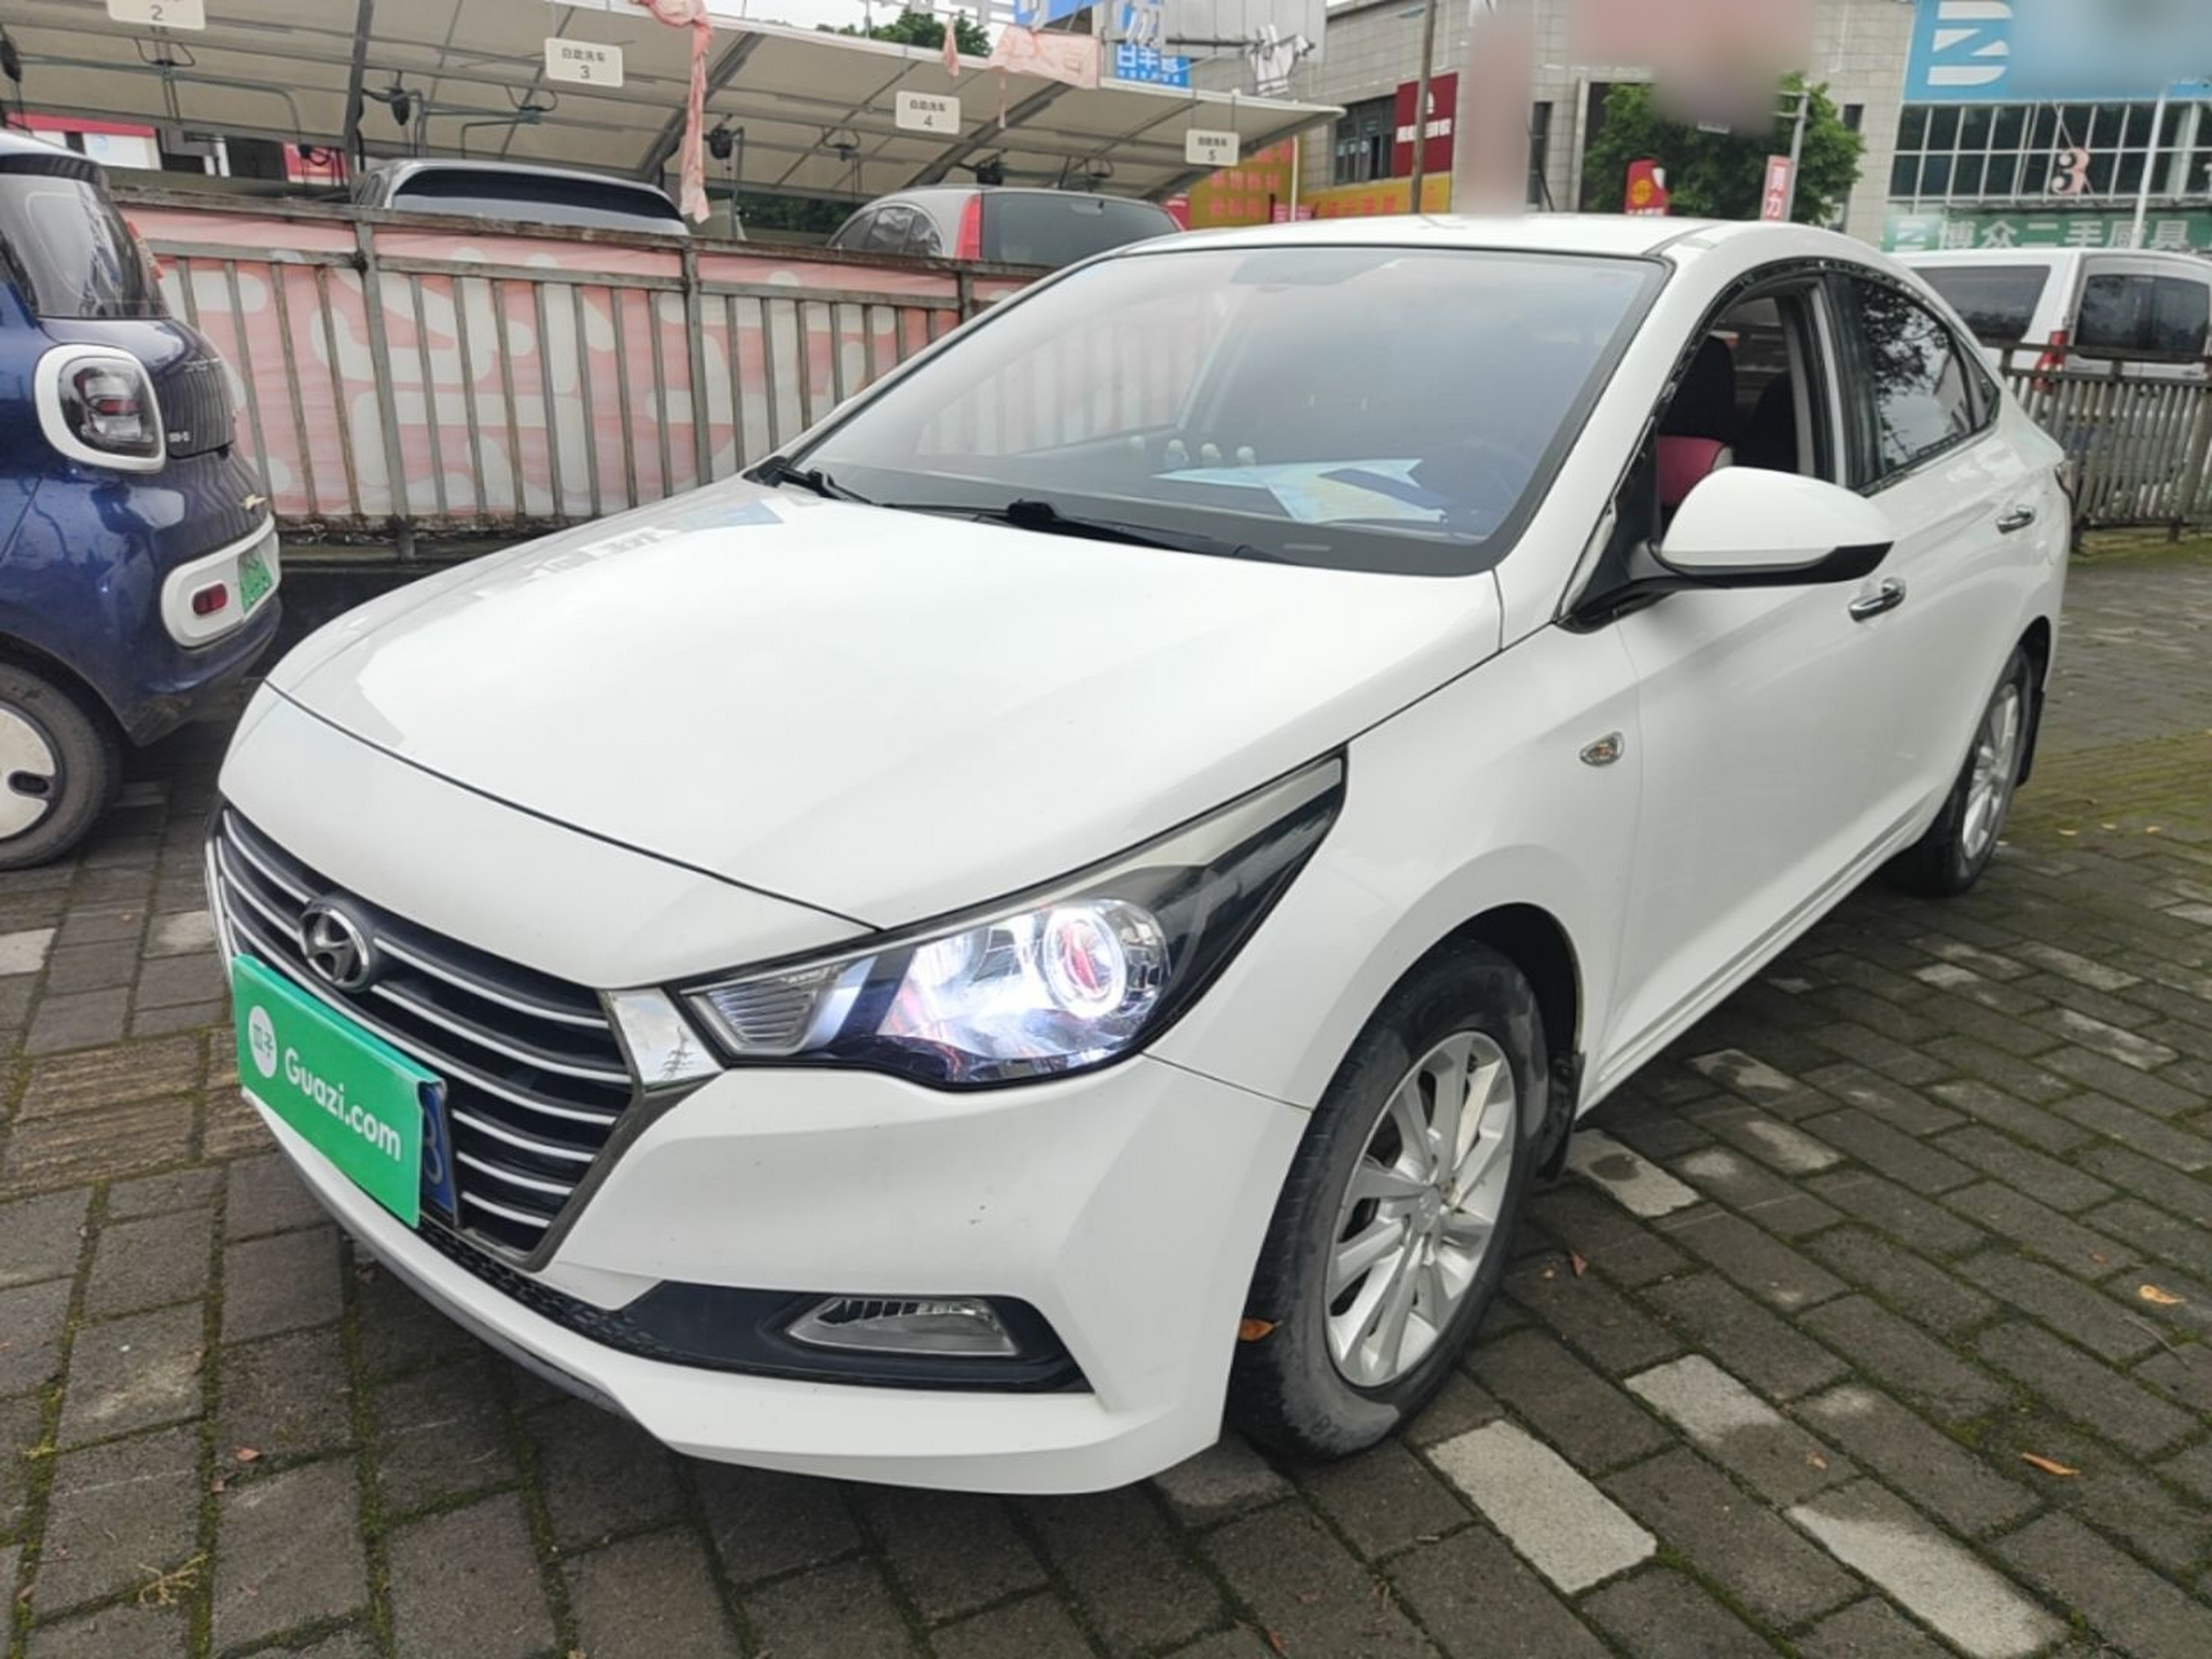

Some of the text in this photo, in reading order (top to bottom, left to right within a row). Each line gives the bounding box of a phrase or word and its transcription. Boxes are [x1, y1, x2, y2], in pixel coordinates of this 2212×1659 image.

[150, 5, 164, 21] 2
[579, 65, 590, 79] 3
[923, 114, 933, 127] 4
[285, 1047, 402, 1161] Guazi.com
